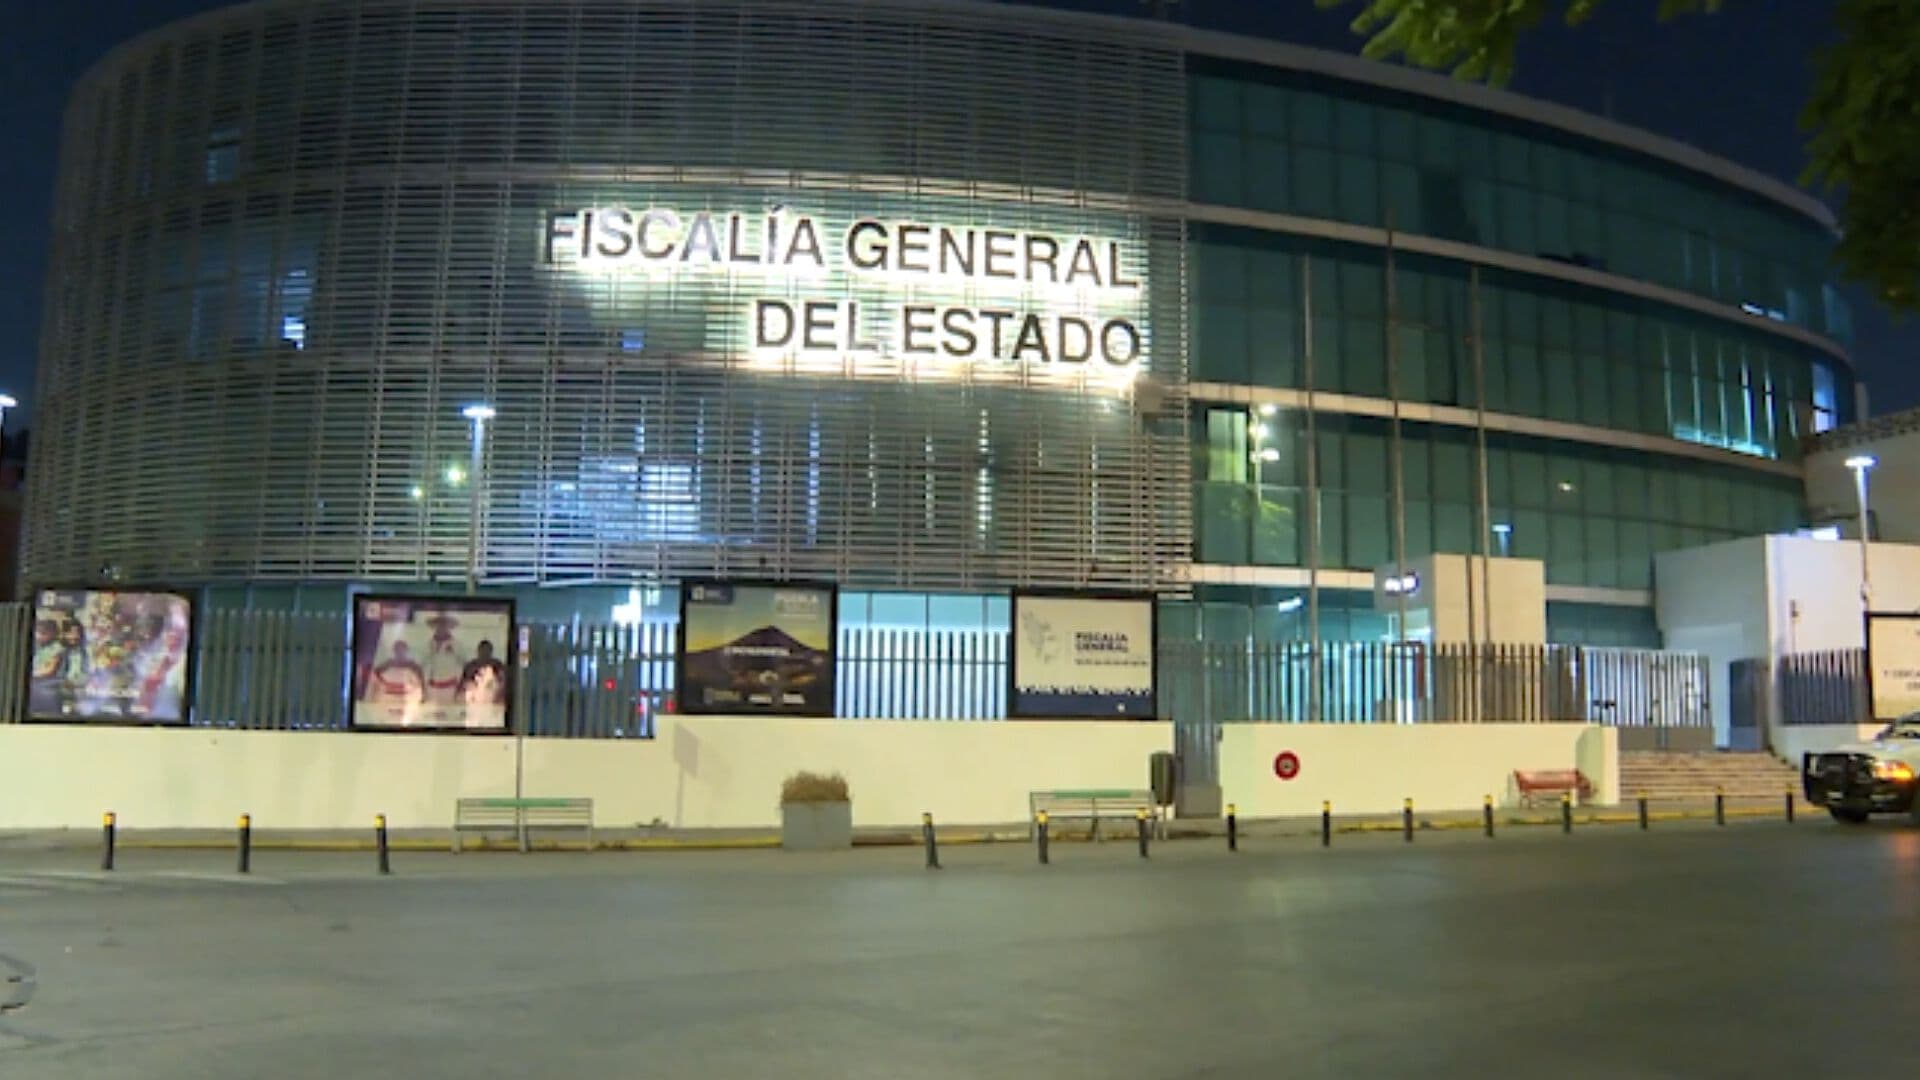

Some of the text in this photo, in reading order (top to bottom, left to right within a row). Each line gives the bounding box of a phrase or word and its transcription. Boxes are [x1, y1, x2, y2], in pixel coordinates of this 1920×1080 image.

[546, 203, 1138, 288] FISCALÍA GENERAL
[756, 299, 1141, 365] DEL ESTADO
